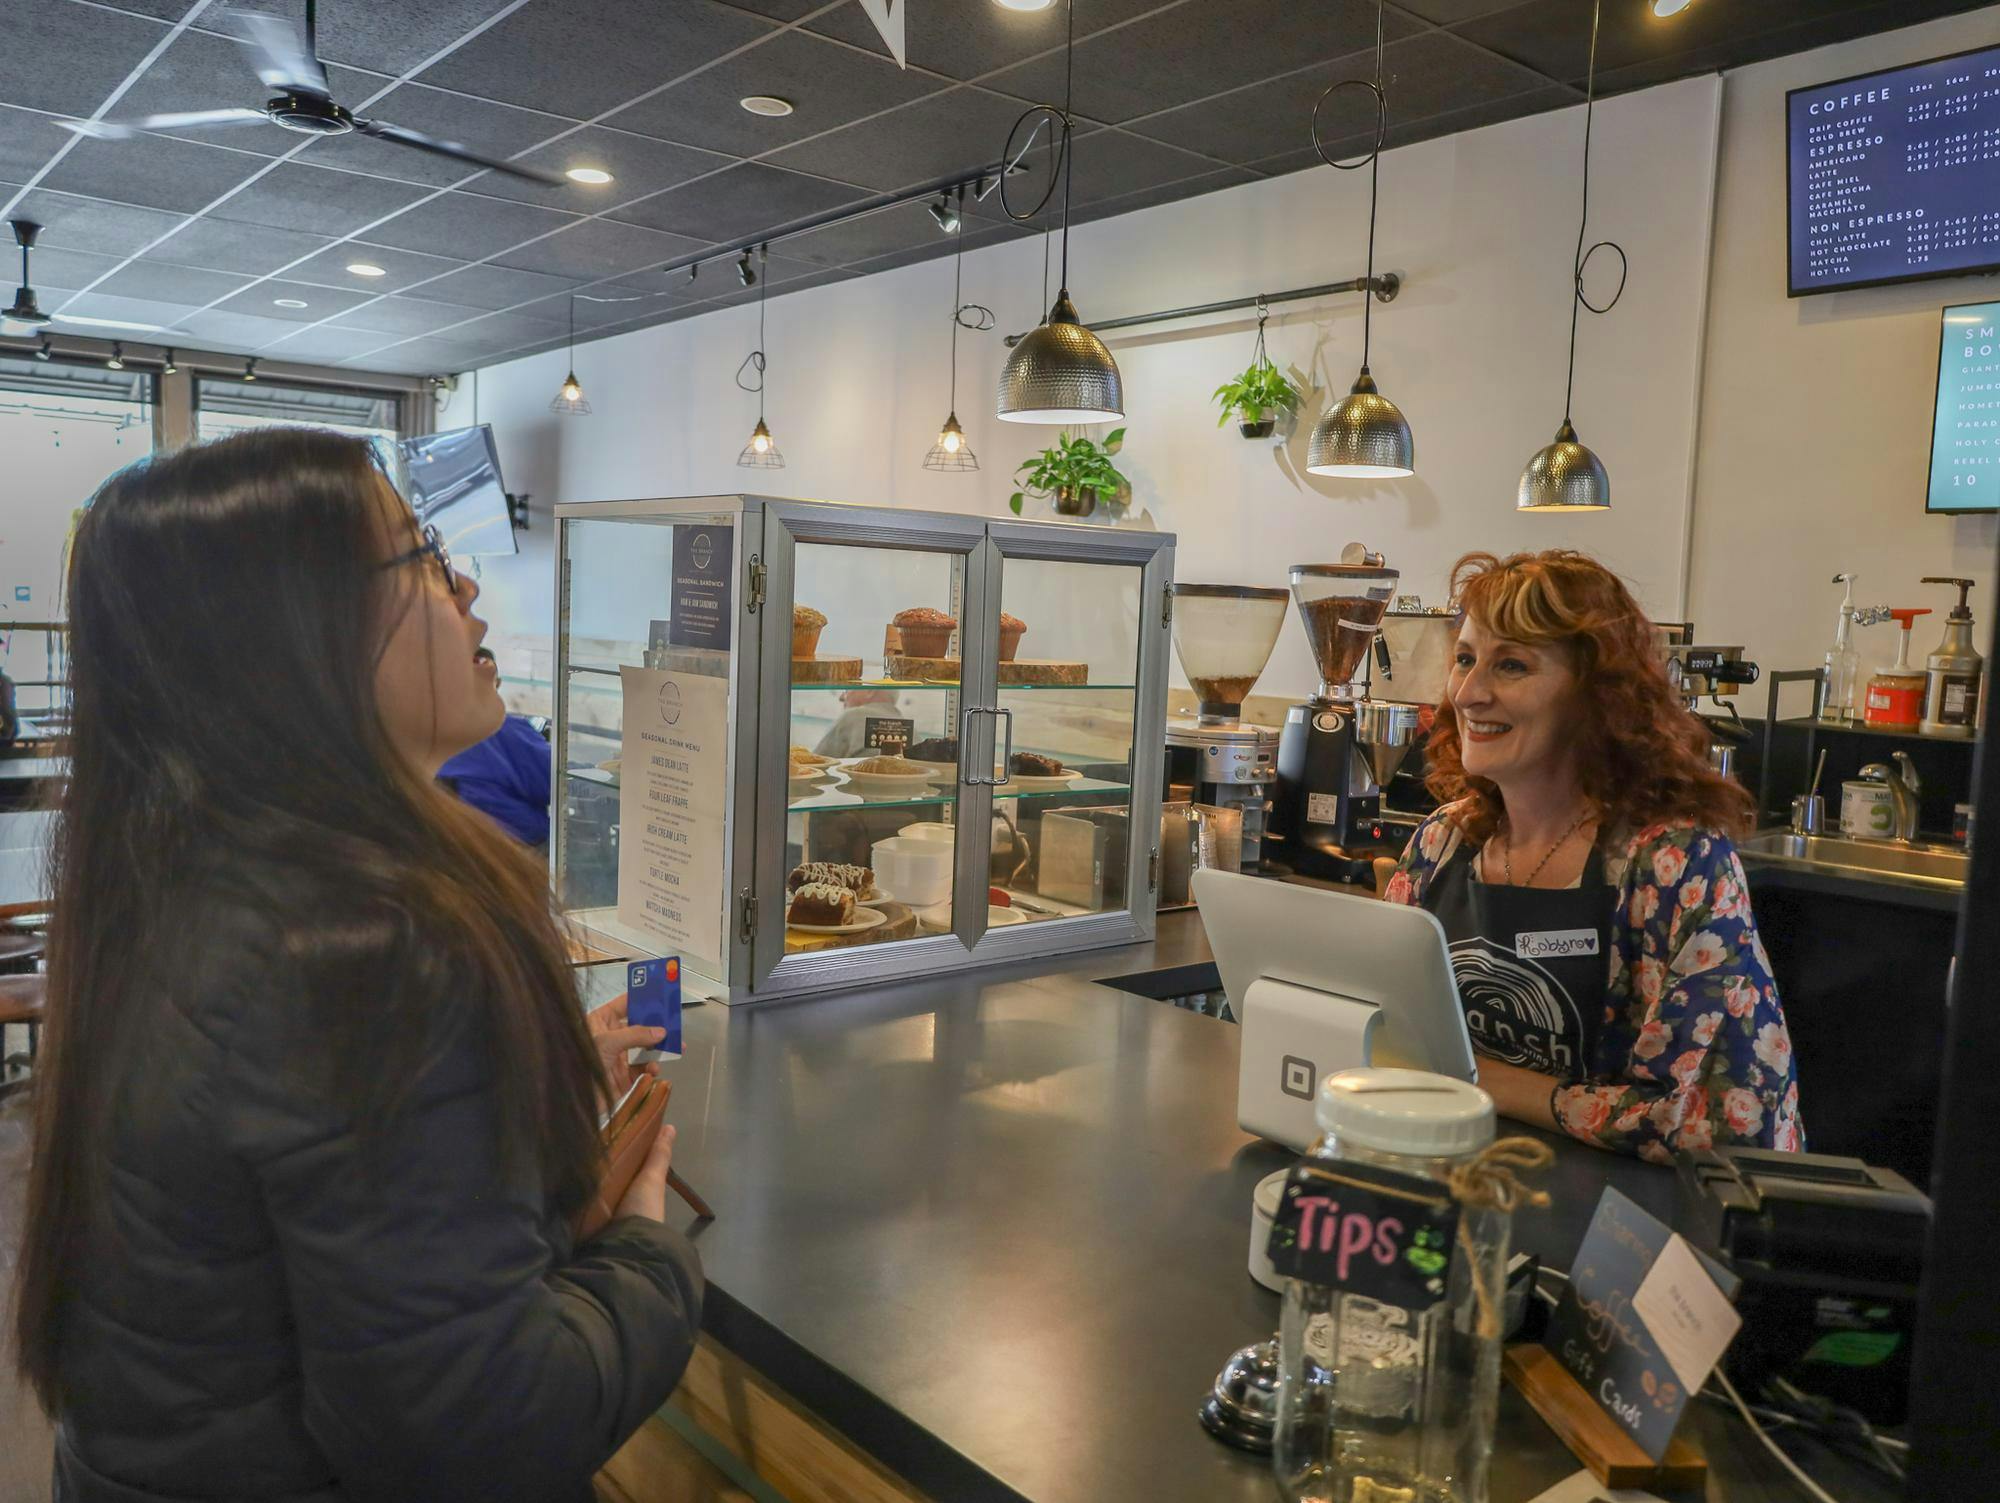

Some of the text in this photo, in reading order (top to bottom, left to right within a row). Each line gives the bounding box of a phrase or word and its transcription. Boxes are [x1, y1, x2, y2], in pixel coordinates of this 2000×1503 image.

[1984, 68, 2000, 77] 20
[1809, 88, 1890, 115] COFFEE
[1809, 115, 1873, 134] DRIP COFFEE
[1809, 127, 1866, 144] COLD BREW
[1809, 135, 1883, 157] ESPRESSO
[1809, 153, 1866, 169] AMERICANO
[1809, 169, 1837, 180] LATTE
[1809, 176, 1860, 190] CAFE MIEL
[1809, 184, 1871, 200] CAFE MOCHA
[1809, 198, 1852, 211] CARAMEL
[1809, 204, 1866, 218] MACCHIATO
[1810, 208, 1924, 234] NON ESPRESSO
[1810, 232, 1866, 246] CHAI LATTE
[1810, 239, 1890, 257] HOT CHOCOLATE
[1810, 256, 1849, 267] MATCHA
[1810, 266, 1851, 277] HOT TEA
[677, 577, 724, 587] SEASONAL SANDWICH
[641, 732, 668, 744] SEASONAL
[685, 743, 701, 752] MENU
[657, 827, 673, 840] CREAM
[673, 832, 688, 845] LATTE
[1294, 1195, 1403, 1281] Tips
[1563, 1338, 1595, 1380] Gift
[1600, 1377, 1643, 1430] Cards
